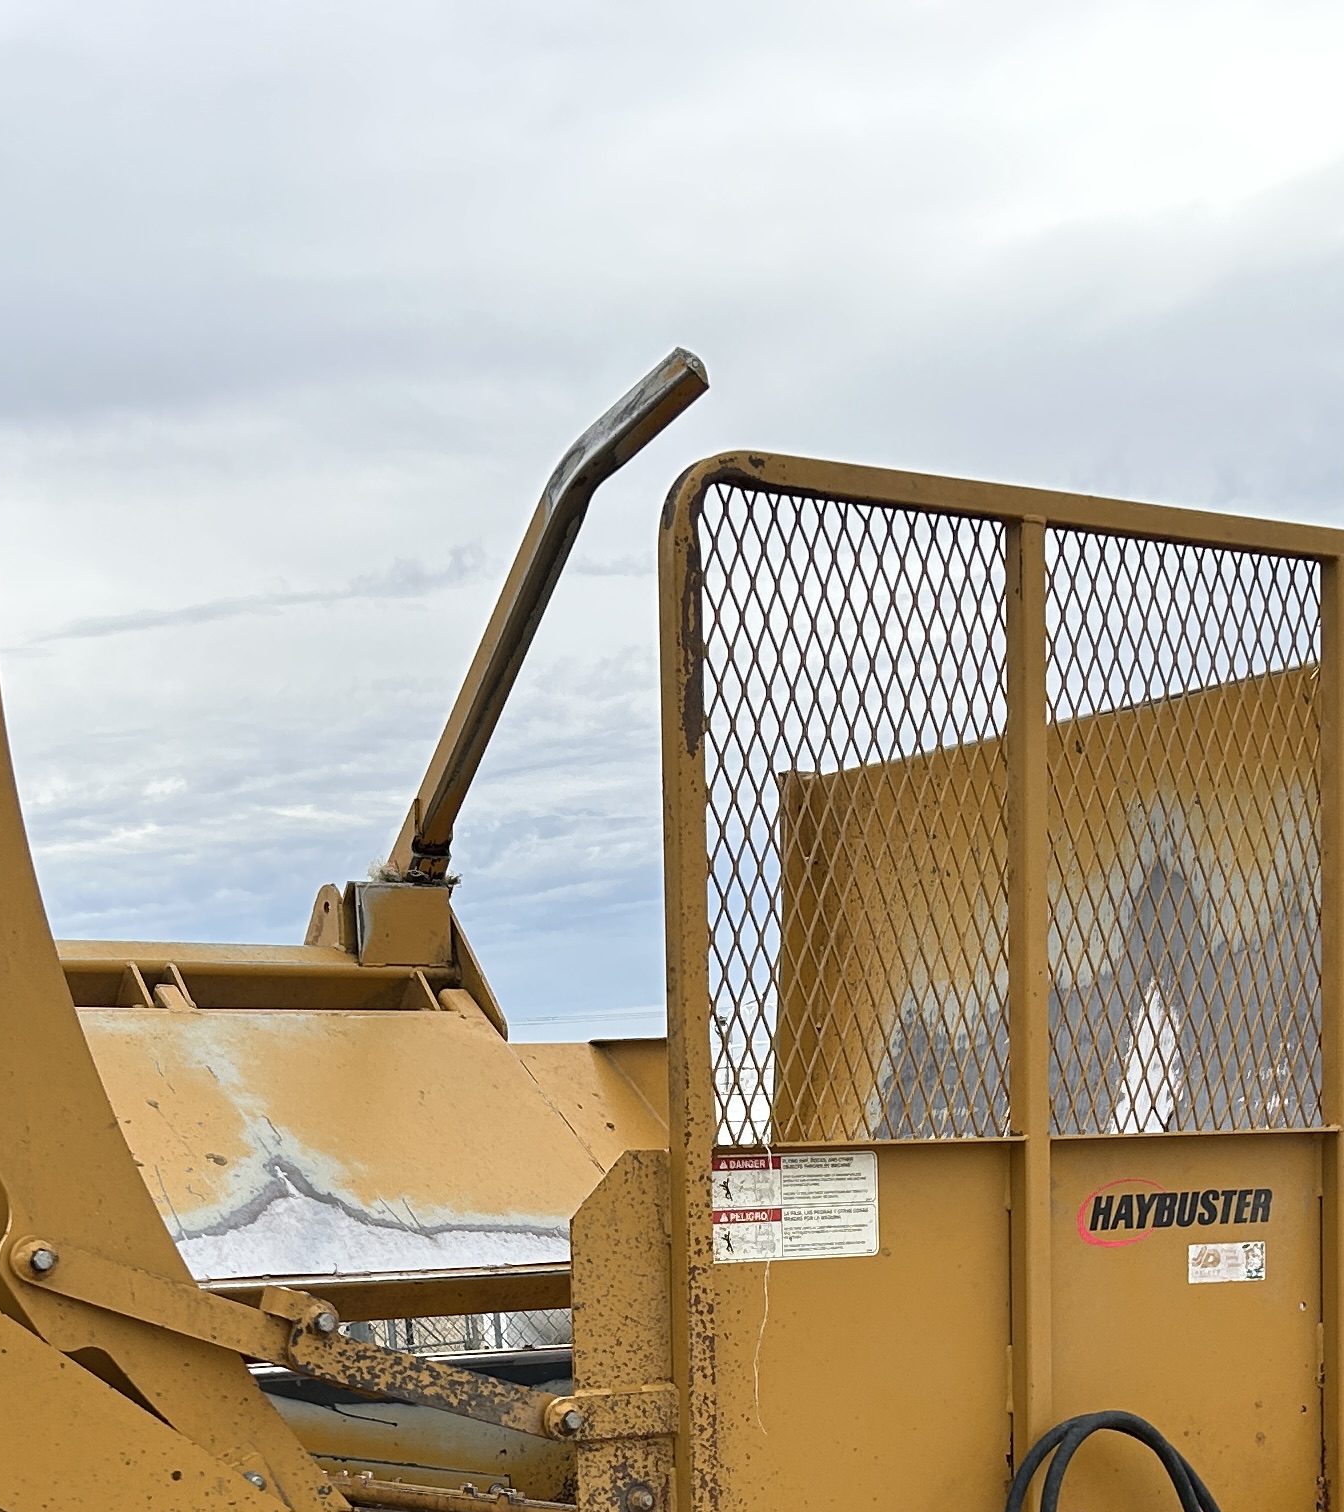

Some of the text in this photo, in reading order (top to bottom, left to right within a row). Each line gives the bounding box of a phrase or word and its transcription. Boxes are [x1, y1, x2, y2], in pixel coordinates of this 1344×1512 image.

[729, 1159, 766, 1169] DANGER
[1089, 1187, 1273, 1232] HAYBUSTER
[730, 1211, 768, 1222] PELIGRO
